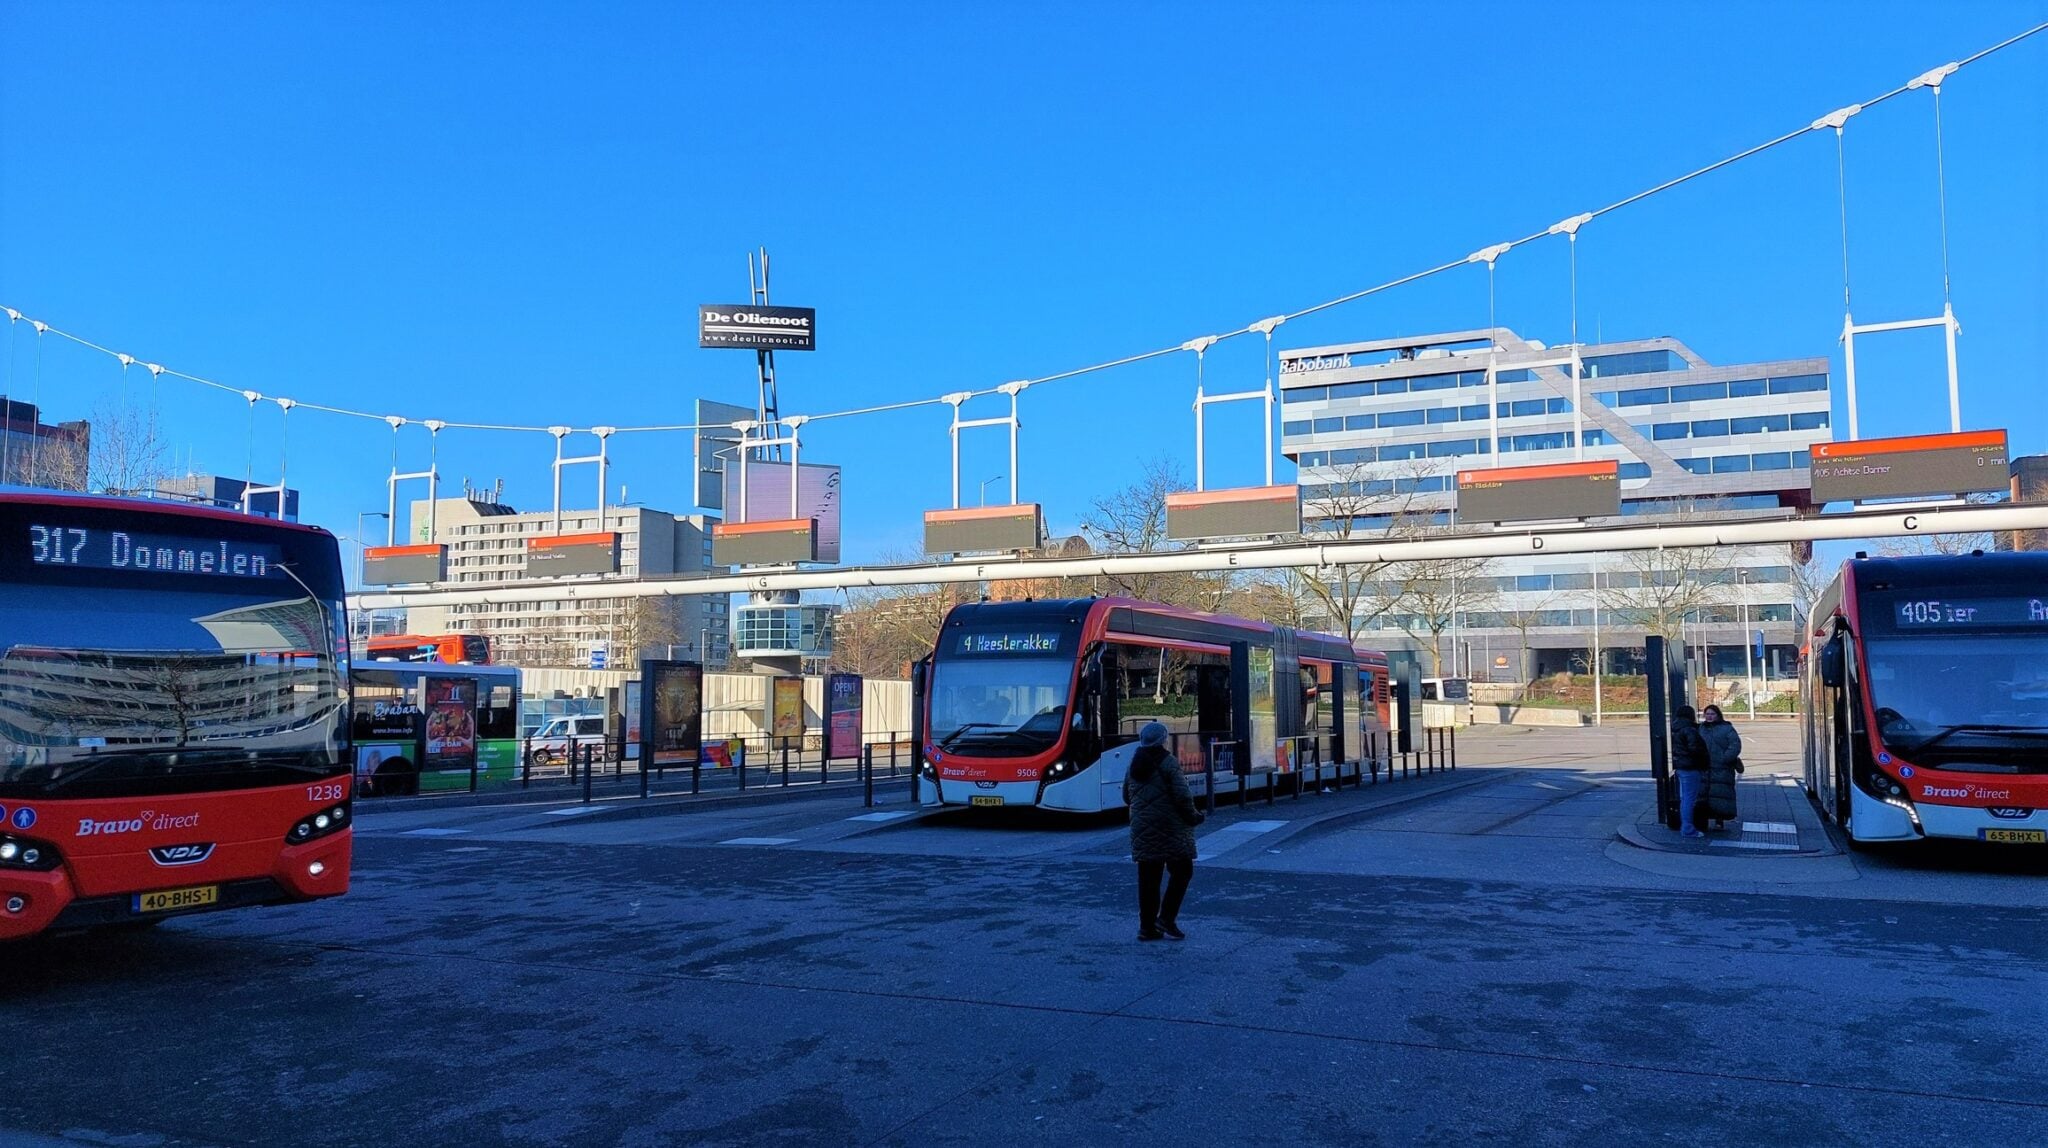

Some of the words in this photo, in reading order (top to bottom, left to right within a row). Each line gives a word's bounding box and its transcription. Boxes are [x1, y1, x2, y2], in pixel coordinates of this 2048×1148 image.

[704, 312, 730, 323] De
[733, 312, 809, 327] Olienoot
[704, 334, 809, 346] www.deolienoot.nl
[1279, 353, 1352, 374] Rabobank
[1820, 446, 1828, 456] C
[1903, 516, 1918, 530] C
[1532, 537, 1544, 549] D
[30, 525, 87, 565] 317
[112, 532, 267, 577] Dommelen
[1229, 554, 1237, 565] E
[978, 566, 984, 576] F
[759, 578, 767, 587] G
[568, 588, 576, 597] H
[1902, 602, 1941, 623] 405
[964, 635, 971, 651] 4
[942, 767, 965, 776] Bravo
[967, 768, 987, 777] direct
[1016, 768, 1038, 777] 9506
[306, 785, 343, 801] 1238
[1922, 785, 1968, 797] Bravo
[1974, 787, 2010, 799] direct
[76, 817, 142, 837] Bravo
[151, 811, 200, 831] direct
[1990, 830, 2041, 842] 65-BHX-1
[159, 847, 205, 860] VDL
[145, 886, 213, 909] 40-BHS-1
